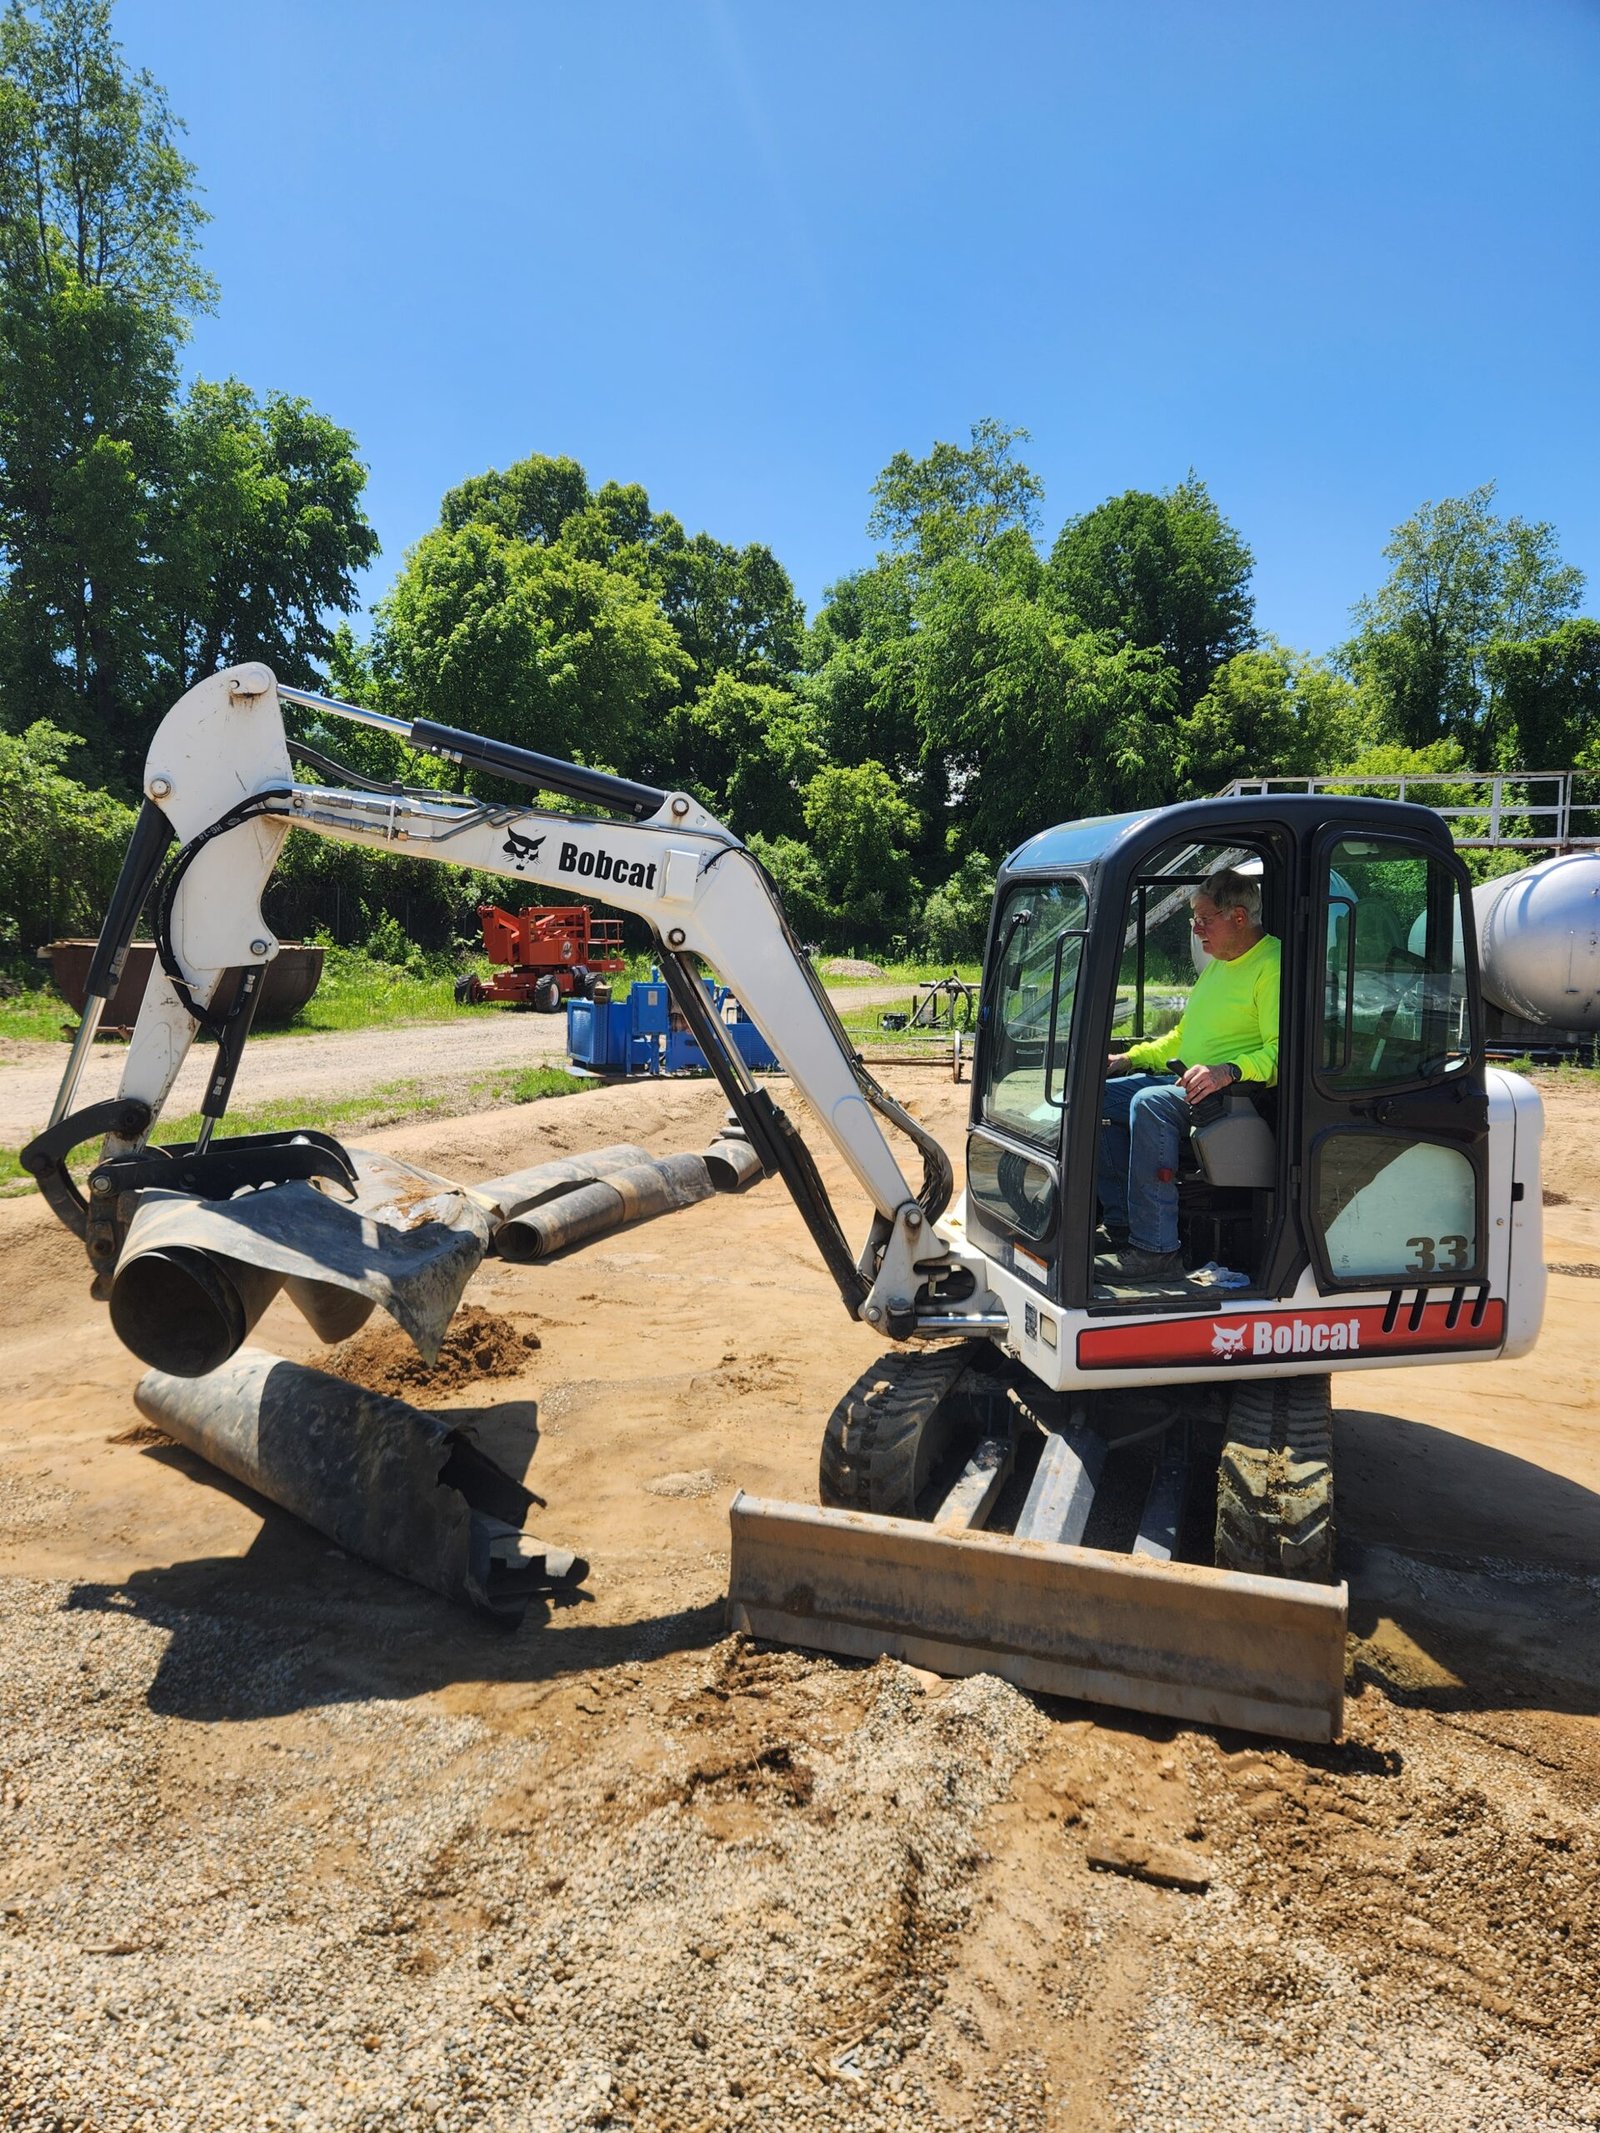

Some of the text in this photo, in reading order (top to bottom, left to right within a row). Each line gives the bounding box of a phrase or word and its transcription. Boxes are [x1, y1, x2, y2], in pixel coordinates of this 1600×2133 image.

[558, 842, 657, 890] Bobcat
[1405, 1235, 1476, 1273] 33
[1253, 1319, 1360, 1355] Bobcat
